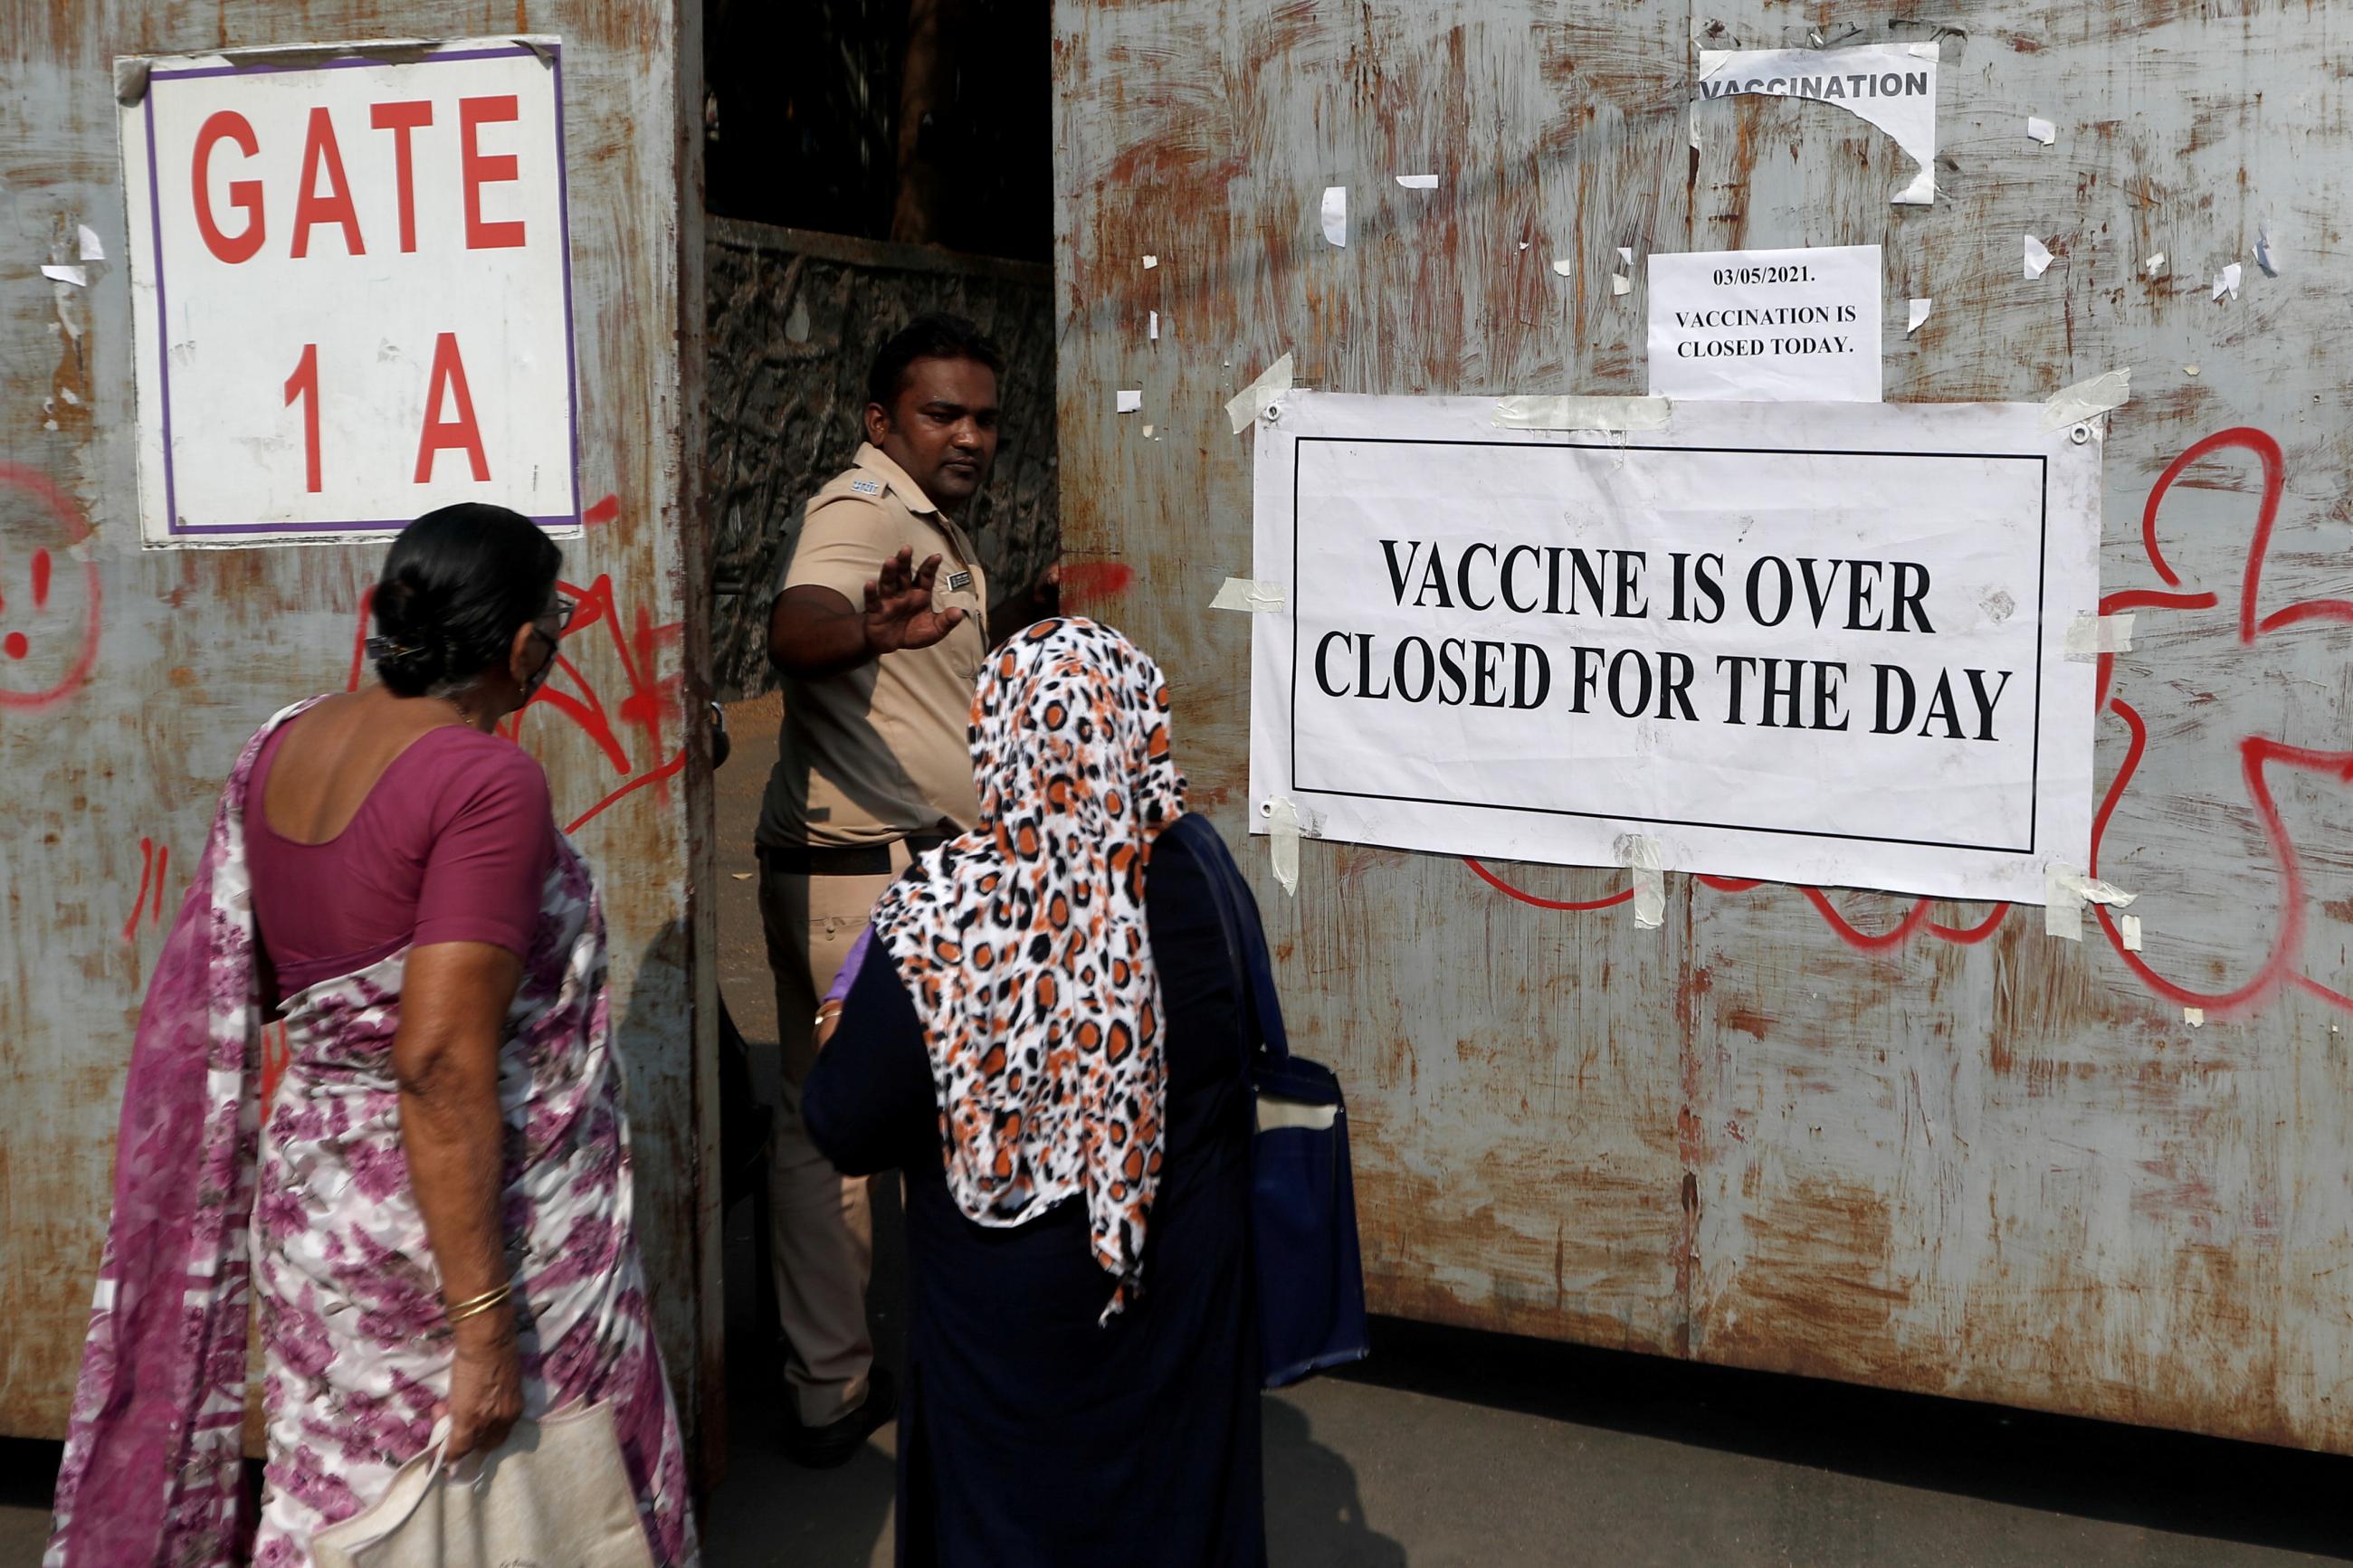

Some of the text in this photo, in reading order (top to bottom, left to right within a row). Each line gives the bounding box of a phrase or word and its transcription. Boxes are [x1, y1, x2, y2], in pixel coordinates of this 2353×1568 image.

[193, 95, 526, 264] GATE
[1675, 305, 1856, 328] VACCINATION IS
[1712, 266, 1815, 286] 03/05/2021.
[1677, 337, 1853, 358] CLOSED TODAY.
[284, 332, 491, 493] 1 A
[1378, 539, 1937, 634] VACCINE IS OVER
[1314, 631, 2013, 742] CLOSED FOR THE DAY
